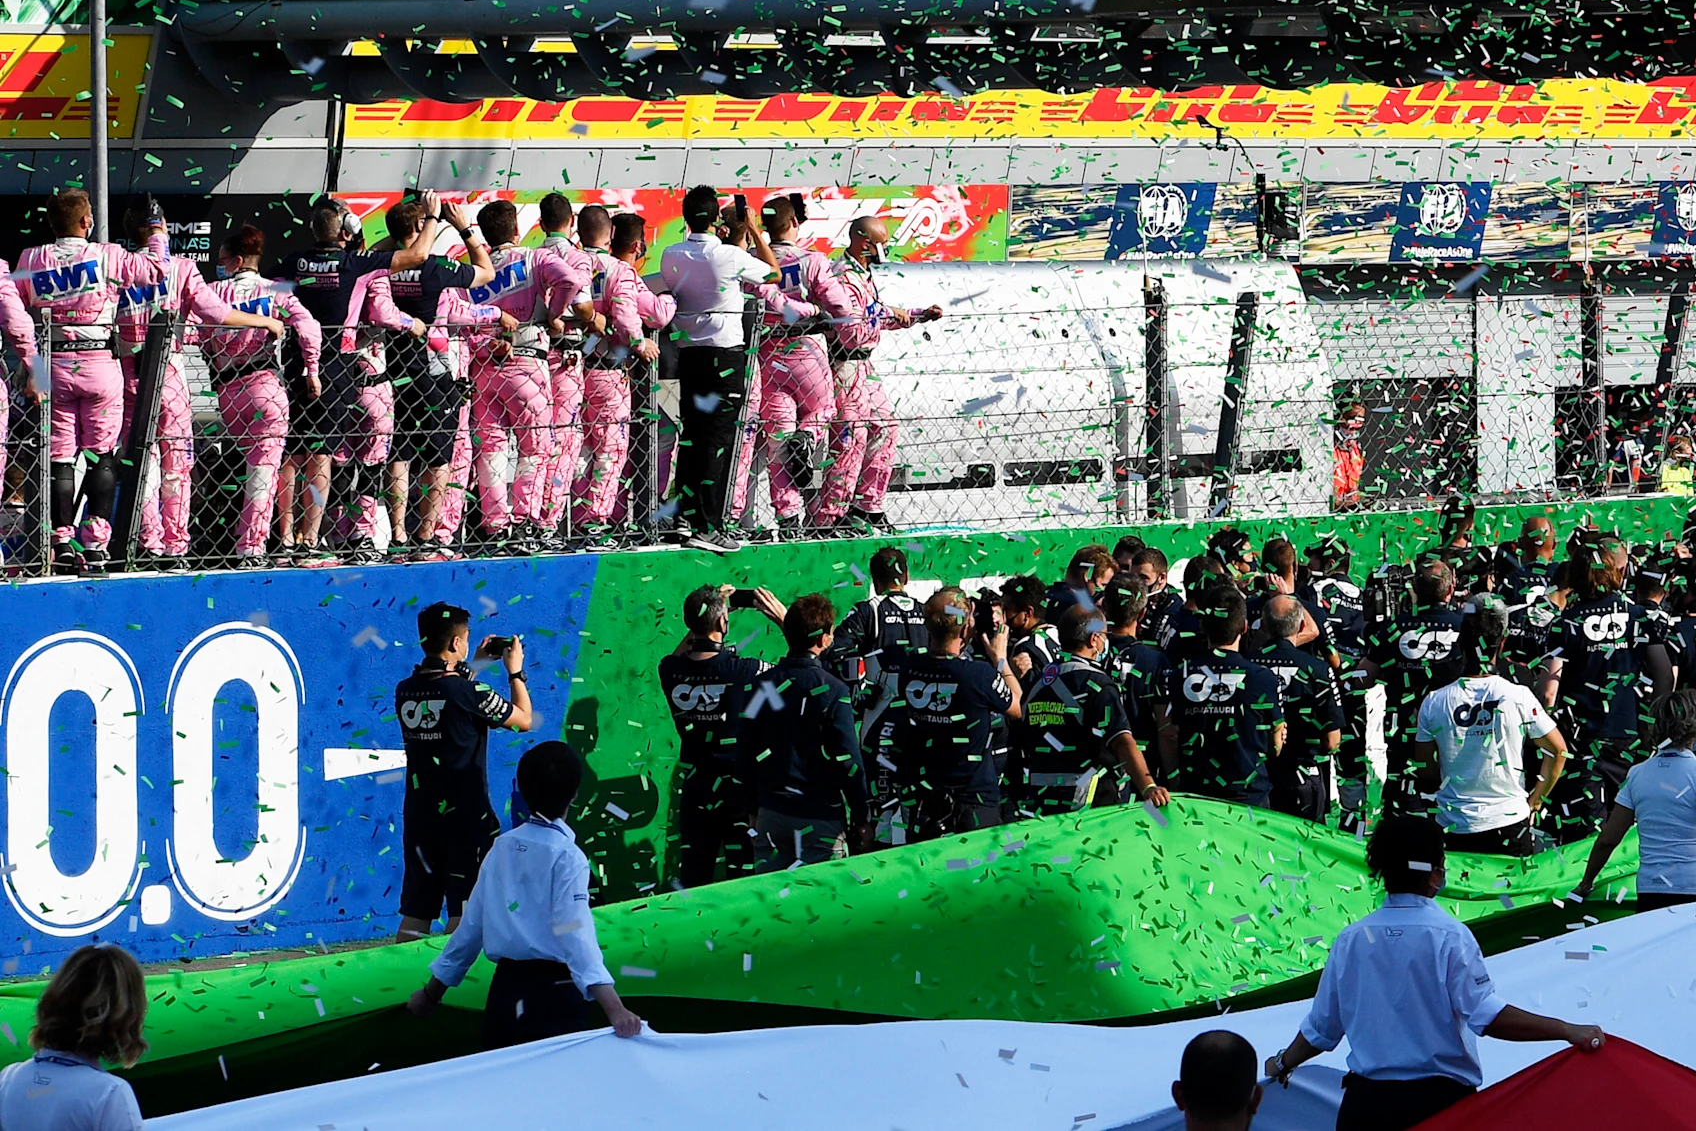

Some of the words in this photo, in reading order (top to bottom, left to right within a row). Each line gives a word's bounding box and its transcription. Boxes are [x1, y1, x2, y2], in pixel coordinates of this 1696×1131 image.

[31, 259, 99, 297] BWT
[309, 261, 340, 272] BWT
[390, 270, 422, 282] BWT
[469, 260, 527, 304] BWT
[0, 620, 307, 937] 0.0
